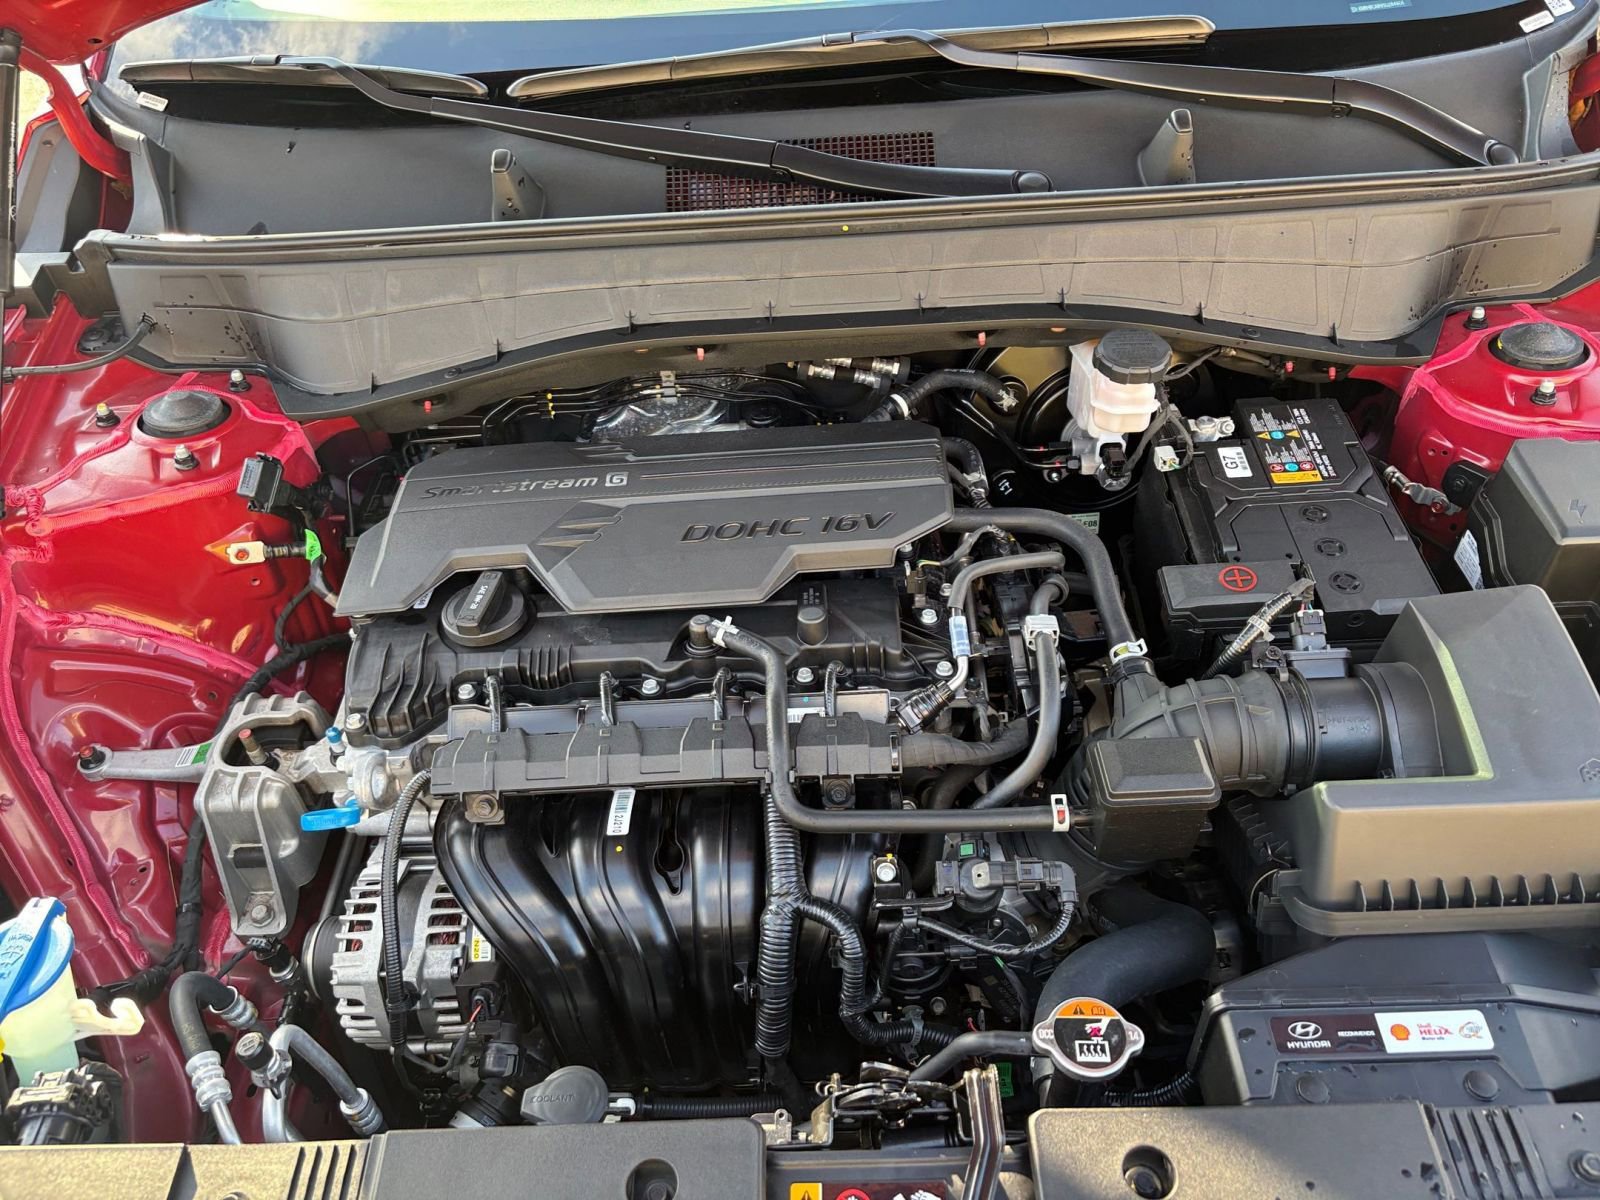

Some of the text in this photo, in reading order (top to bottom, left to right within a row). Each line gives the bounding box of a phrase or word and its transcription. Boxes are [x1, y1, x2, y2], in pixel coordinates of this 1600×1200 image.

[1222, 455, 1239, 470] G7
[421, 476, 599, 499] Smartstream
[680, 511, 896, 544] DOHC 16V
[612, 814, 624, 834] 2J210
[1420, 1026, 1453, 1036] HELIX
[1287, 1040, 1331, 1049] HYUNDAI
[530, 1094, 574, 1104] COOLANT
